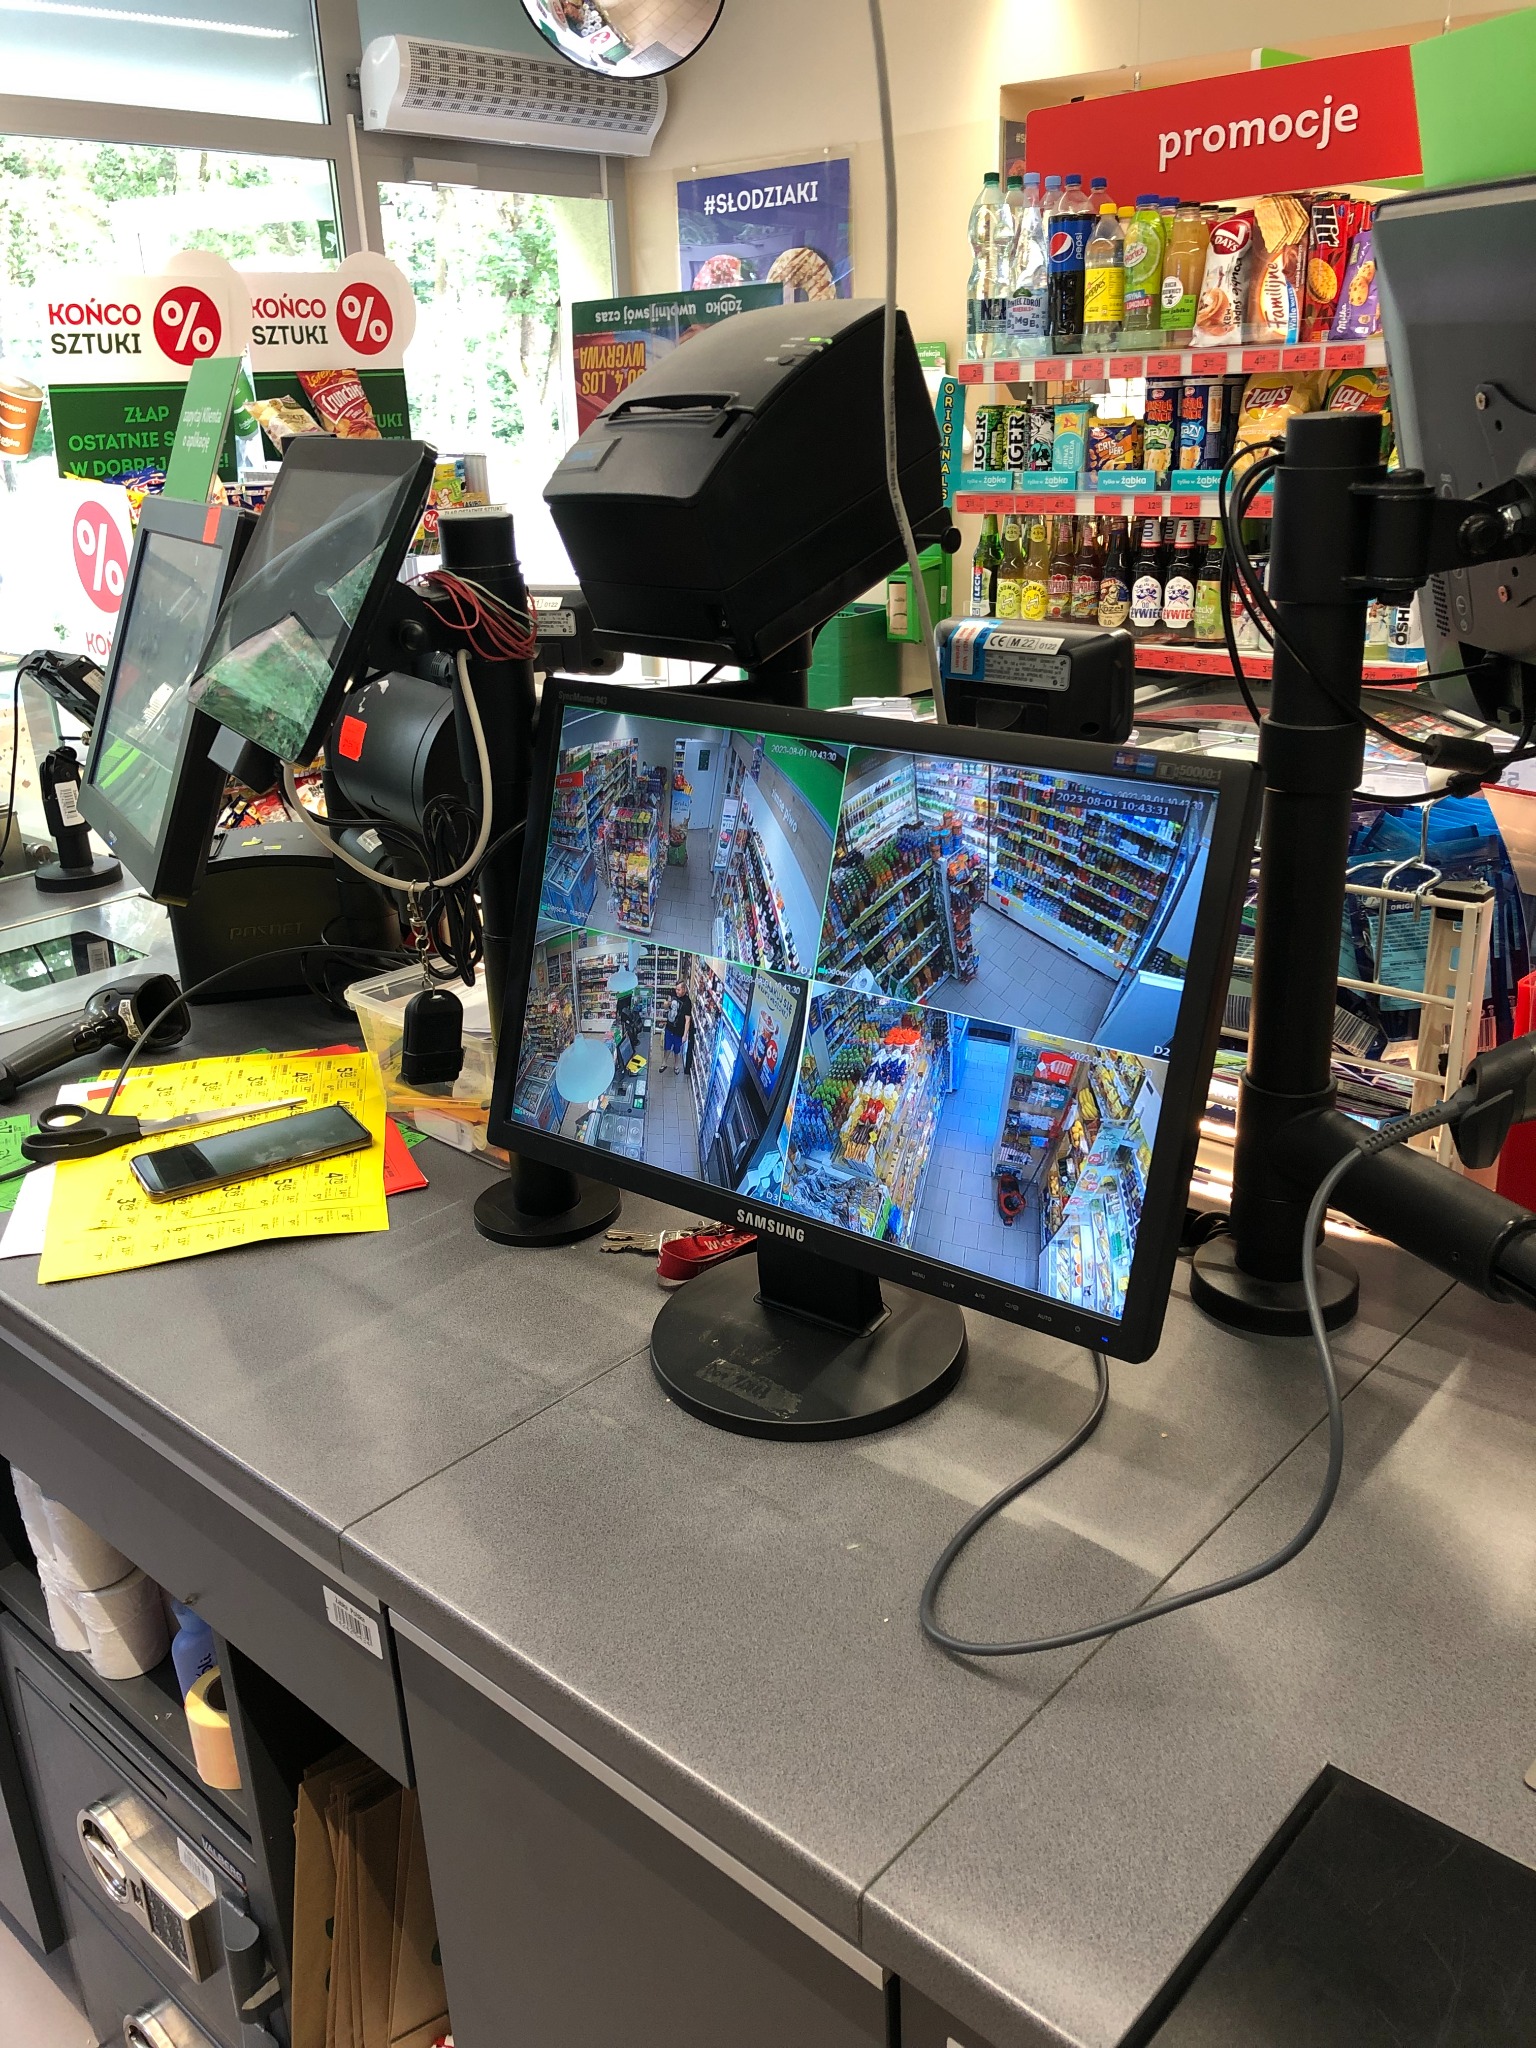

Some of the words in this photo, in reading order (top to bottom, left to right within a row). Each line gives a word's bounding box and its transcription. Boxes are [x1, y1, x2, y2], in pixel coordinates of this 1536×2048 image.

[1158, 96, 1359, 172] promocje
[703, 180, 819, 216] #SŁODZIAKI
[1074, 232, 1084, 260] pepsi
[1214, 235, 1240, 252] DAYS
[251, 293, 327, 319] KOŃCO
[1264, 263, 1287, 329] Familijne
[48, 297, 142, 326] KOŃCO
[594, 309, 621, 325] czas
[623, 304, 650, 325] swój
[651, 302, 697, 323] uwolnij
[705, 293, 743, 315] żabka
[1336, 303, 1347, 334] Milka
[1014, 315, 1029, 327] Mg
[51, 332, 142, 355] SZTUKI
[251, 325, 329, 345] SZTUKI
[579, 341, 646, 370] WYGRYWA
[305, 369, 338, 388] Lorenz
[581, 370, 606, 395] LOS
[1245, 386, 1292, 410] Lay's
[123, 405, 170, 424] ZŁAP
[68, 431, 160, 452] OSTATNIE
[940, 382, 956, 501] ORIGINALS
[973, 413, 988, 471] IGER
[1006, 412, 1026, 472] IGER
[70, 460, 89, 477] W
[983, 475, 1007, 488] żabka
[1044, 475, 1069, 488] żabka
[1120, 475, 1147, 488] żabka
[973, 573, 982, 599] LECH
[1100, 604, 1124, 615] Kozel
[1396, 606, 1410, 646] OSH
[1010, 638, 1021, 647] M
[1021, 639, 1035, 648] 22
[1039, 642, 1057, 650] 0122
[1179, 764, 1222, 780] 50000:1
[1057, 792, 1118, 809] 2023-08-01
[1121, 800, 1169, 816] 10:43:31
[800, 966, 813, 976] D1
[1153, 1045, 1171, 1057] D2
[766, 1192, 779, 1201] D3
[736, 1208, 805, 1243] SAMSUNG
[911, 1270, 926, 1280] MENU
[1037, 1312, 1053, 1322] AUTO
